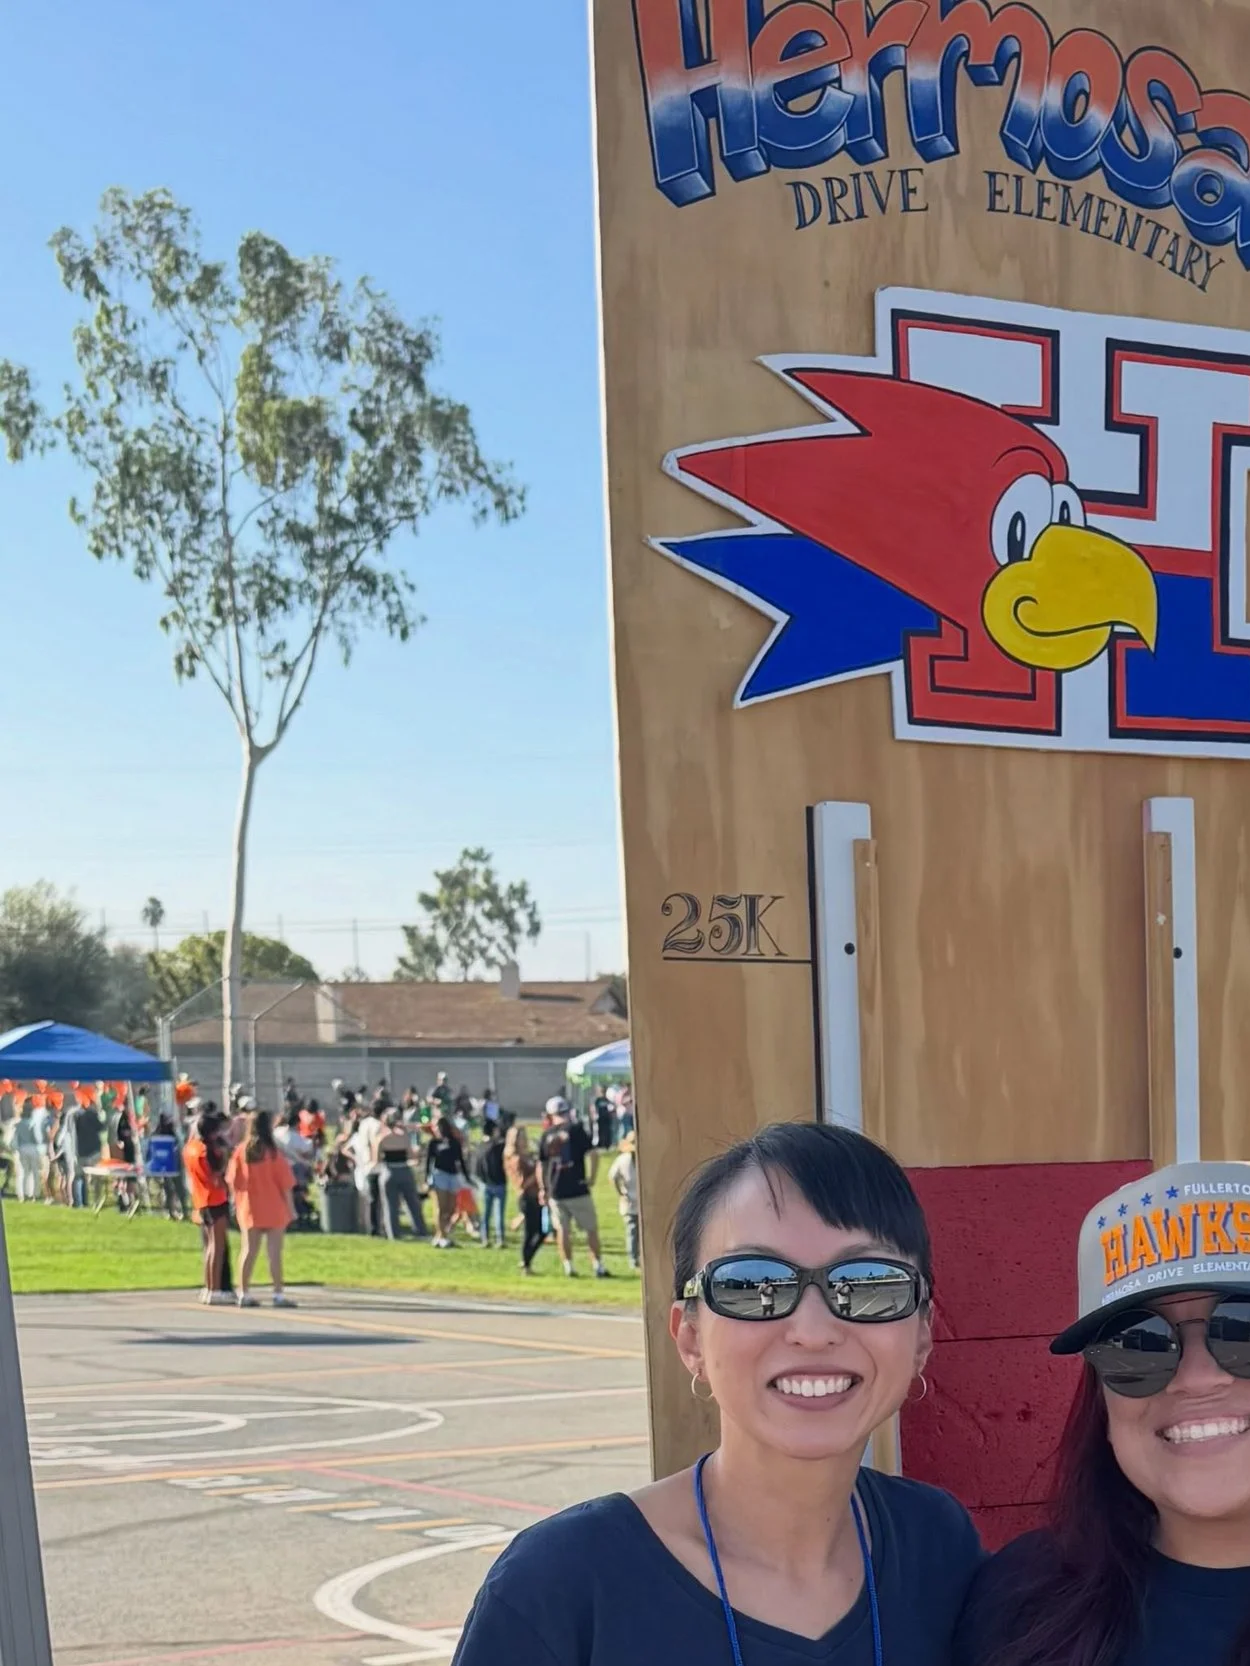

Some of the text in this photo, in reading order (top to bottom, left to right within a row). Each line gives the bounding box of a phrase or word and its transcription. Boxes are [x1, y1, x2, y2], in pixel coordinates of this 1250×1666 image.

[786, 168, 1225, 293] DRIVE ELEMENTARY
[661, 892, 788, 958] 25K
[1147, 1266, 1184, 1283] DRIVE
